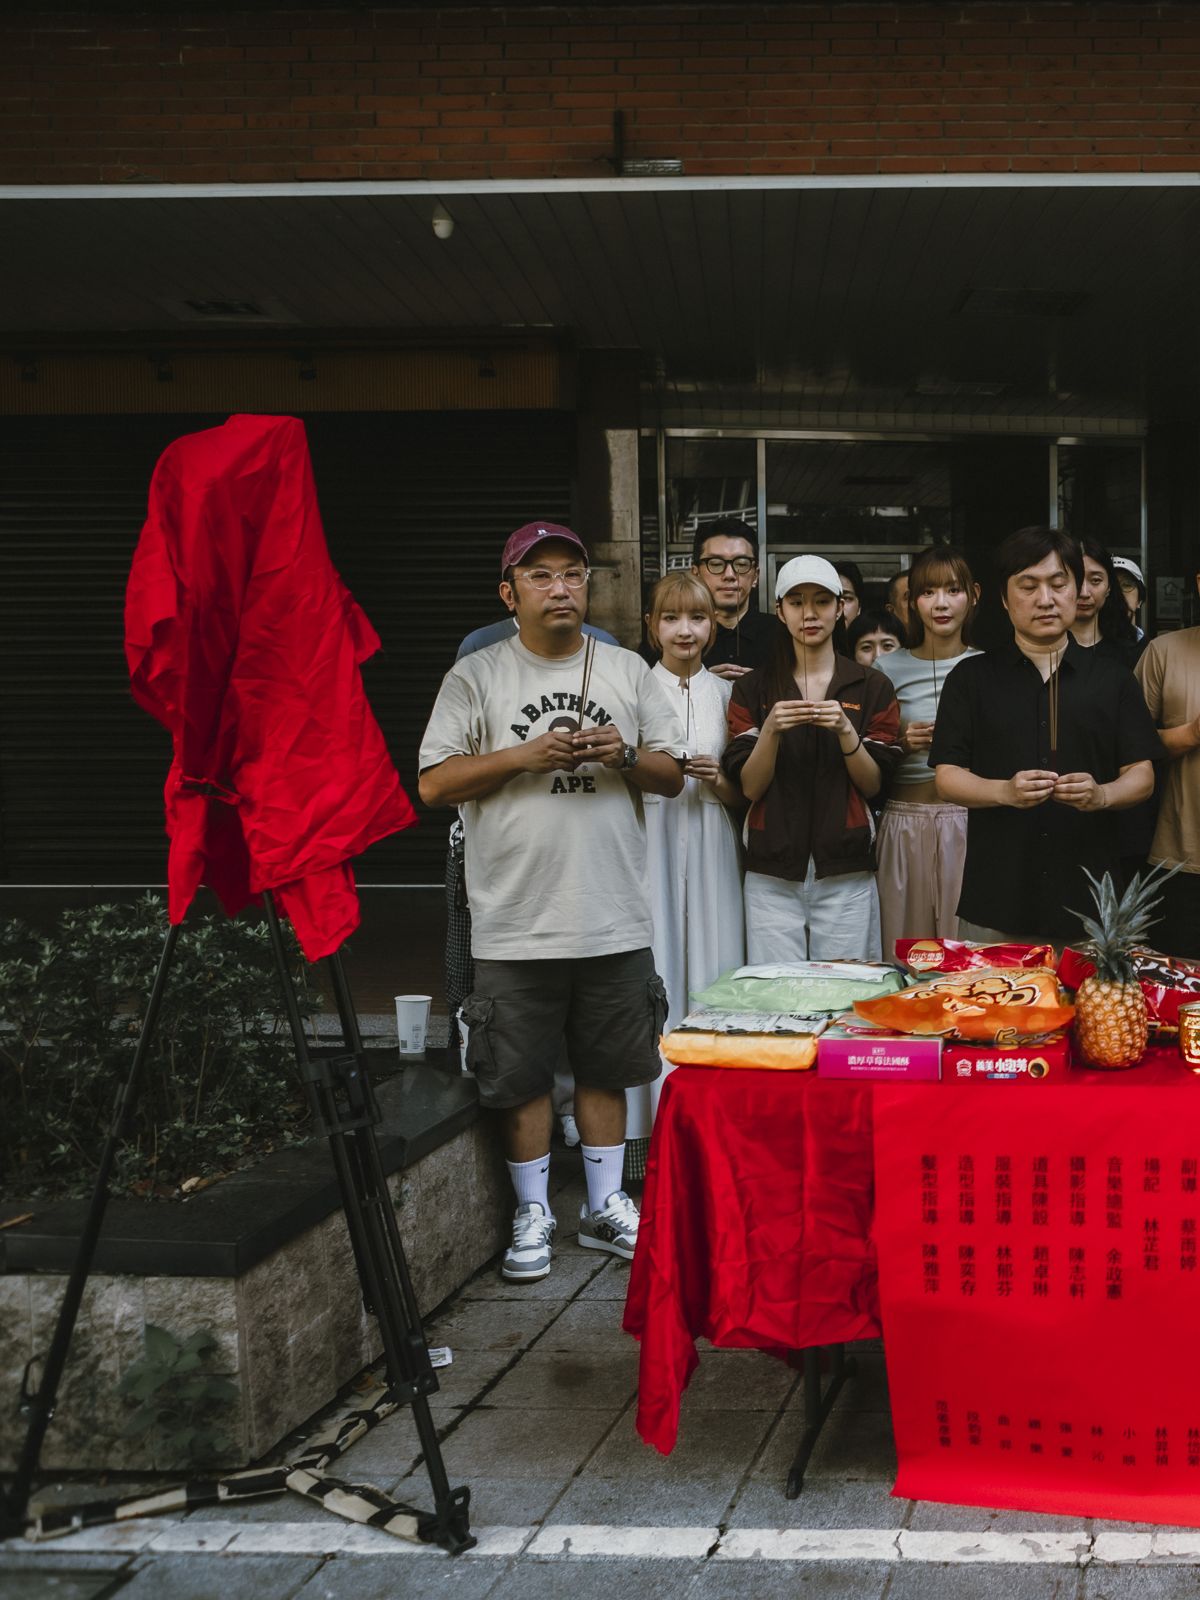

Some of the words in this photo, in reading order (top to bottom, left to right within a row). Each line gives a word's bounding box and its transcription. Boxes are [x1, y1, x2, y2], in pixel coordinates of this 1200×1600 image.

[510, 723, 530, 741] A
[521, 692, 615, 728] BATHIN
[551, 776, 596, 795] APE
